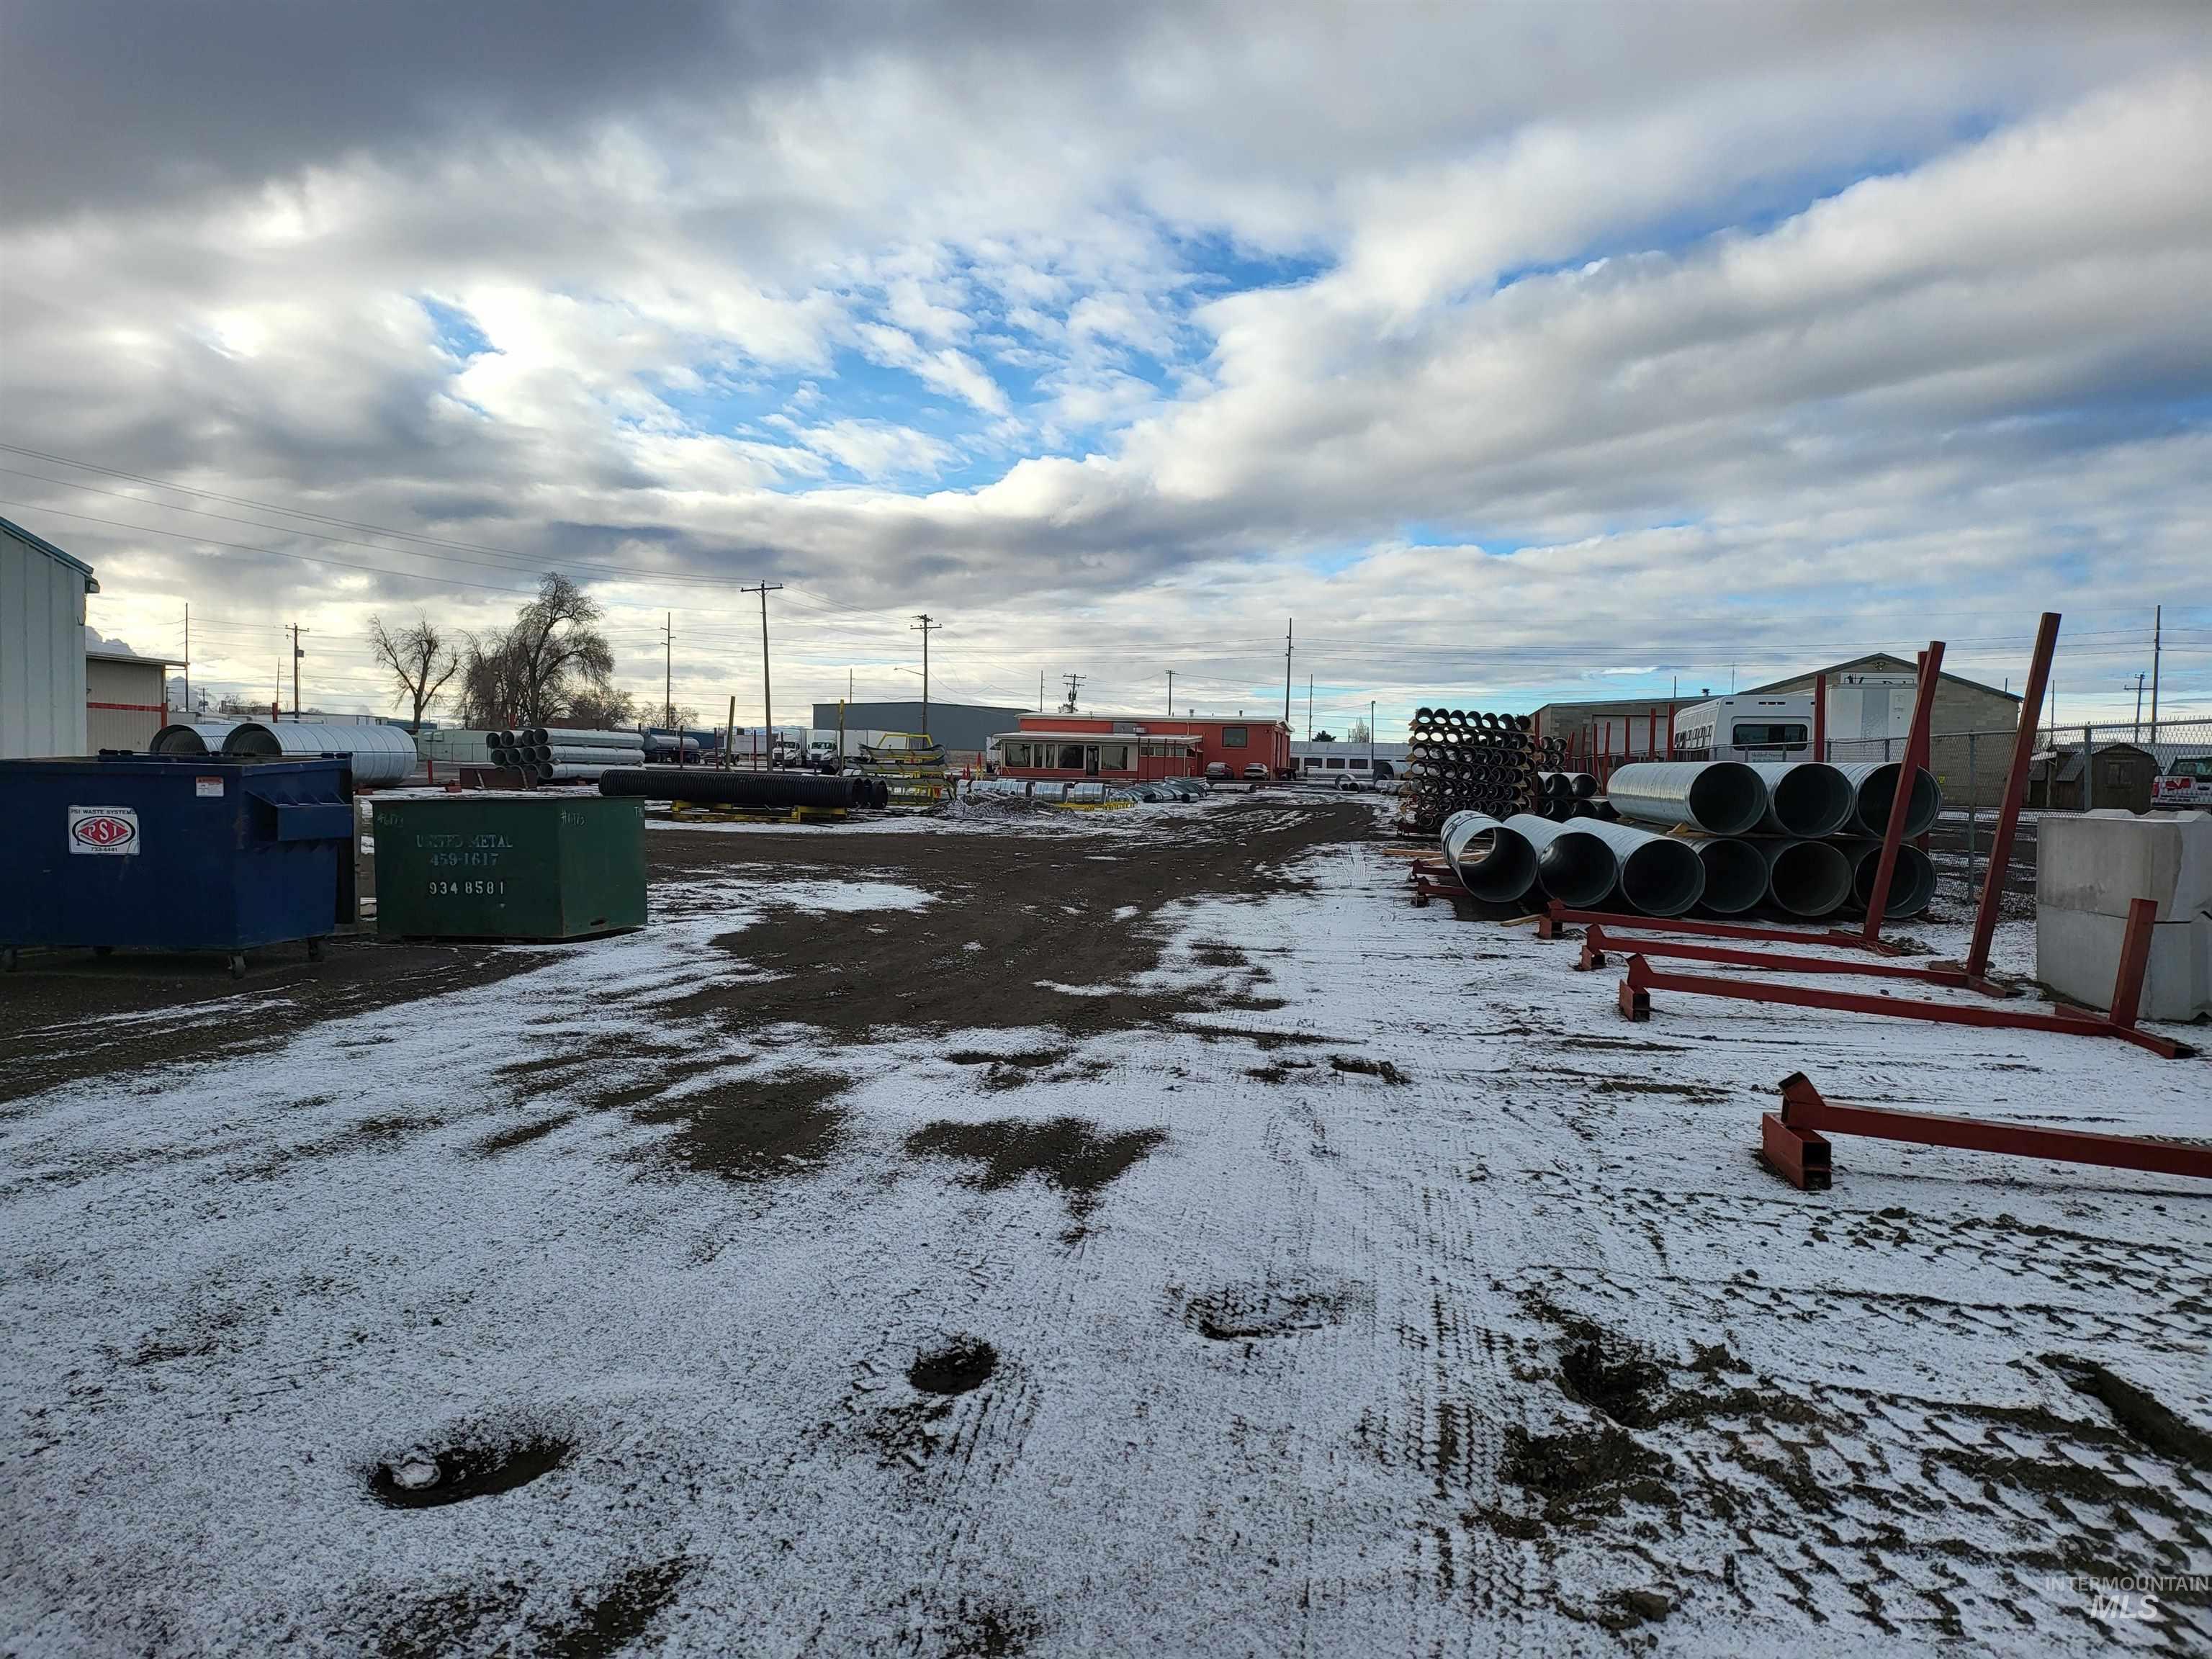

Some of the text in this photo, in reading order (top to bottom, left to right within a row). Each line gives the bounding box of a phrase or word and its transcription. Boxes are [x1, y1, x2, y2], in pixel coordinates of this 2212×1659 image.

[88, 822, 118, 841] PSI
[430, 852, 499, 866] 459-1617
[429, 881, 504, 895] 934 8581
